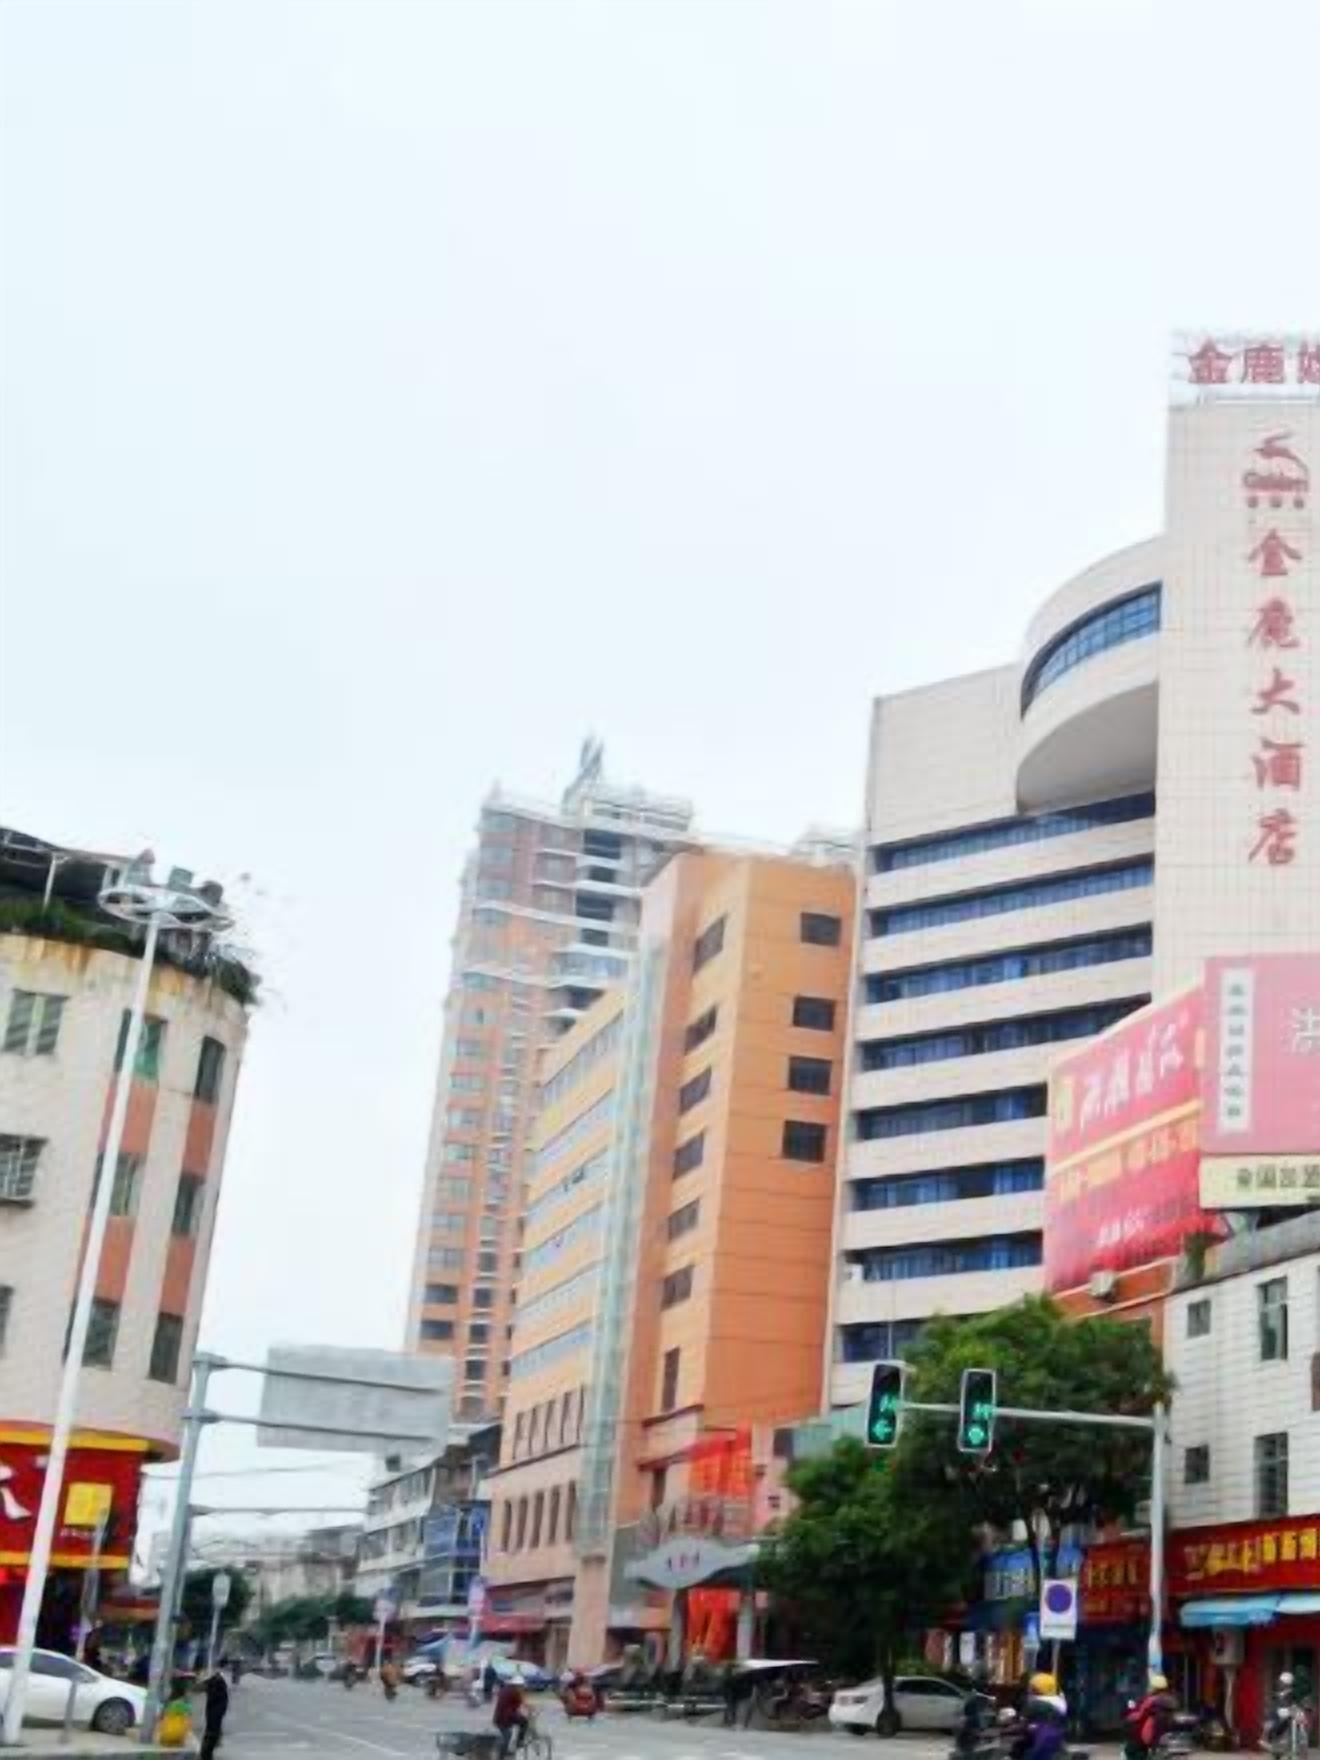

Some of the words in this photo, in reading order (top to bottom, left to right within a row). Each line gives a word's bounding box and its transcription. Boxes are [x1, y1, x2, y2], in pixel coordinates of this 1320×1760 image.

[1247, 529, 1303, 866] 金鹿大酒店
